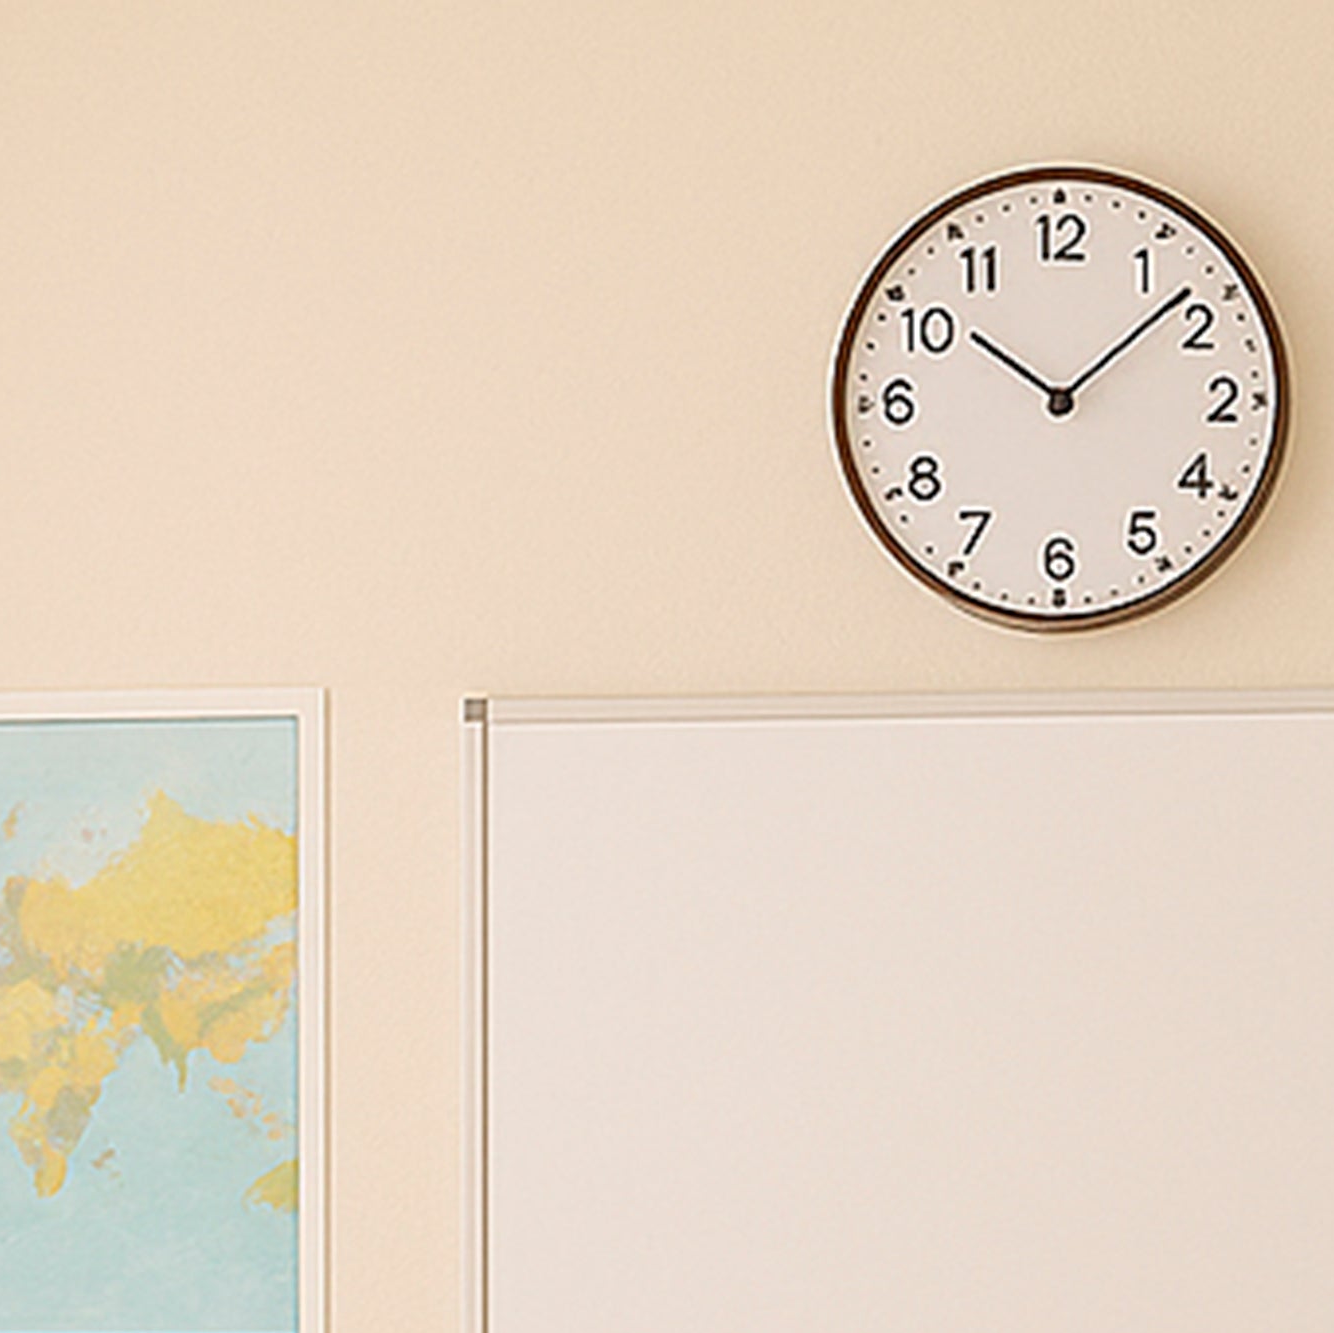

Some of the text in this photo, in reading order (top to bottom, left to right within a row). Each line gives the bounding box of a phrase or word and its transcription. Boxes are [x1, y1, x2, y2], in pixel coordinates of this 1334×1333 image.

[1036, 213, 1087, 262] 12
[959, 245, 998, 293] 11
[1134, 247, 1151, 294] 1
[899, 306, 955, 354] 10
[1181, 302, 1216, 351] 2
[882, 377, 916, 426] 6
[1205, 375, 1240, 424] 2
[907, 455, 942, 502] 8
[1177, 452, 1215, 500] 4
[958, 510, 993, 556] 7
[1126, 510, 1158, 556] 5
[1043, 537, 1076, 583] 6
